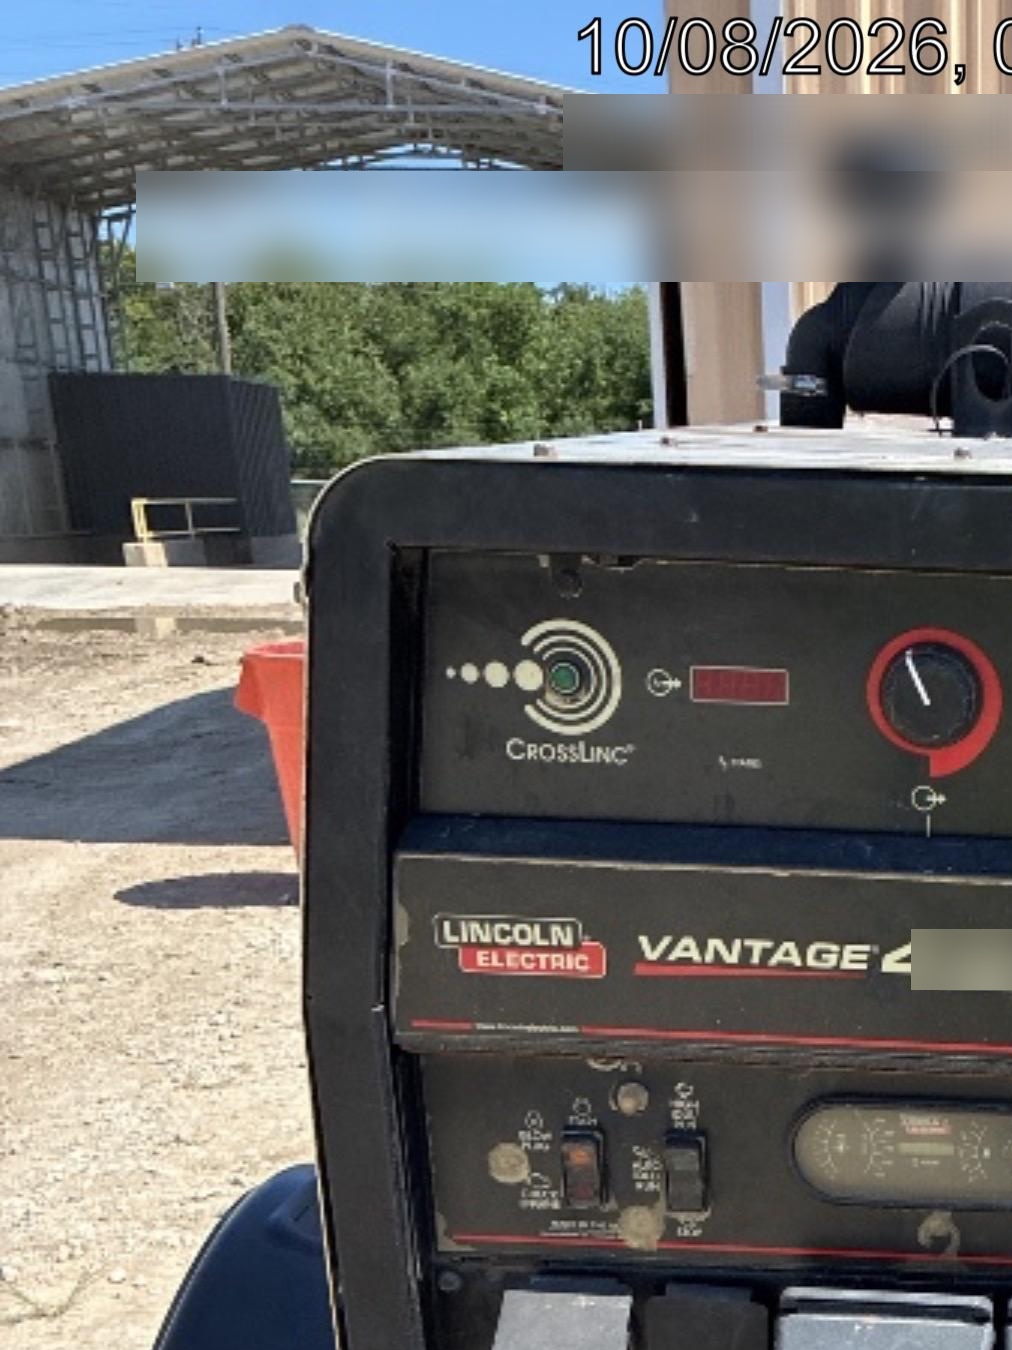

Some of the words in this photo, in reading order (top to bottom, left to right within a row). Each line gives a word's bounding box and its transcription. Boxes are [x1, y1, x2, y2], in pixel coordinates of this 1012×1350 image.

[442, 920, 574, 947] LINCOLN
[475, 950, 590, 971] ELECTRIC
[638, 935, 871, 970] VANTAGE
